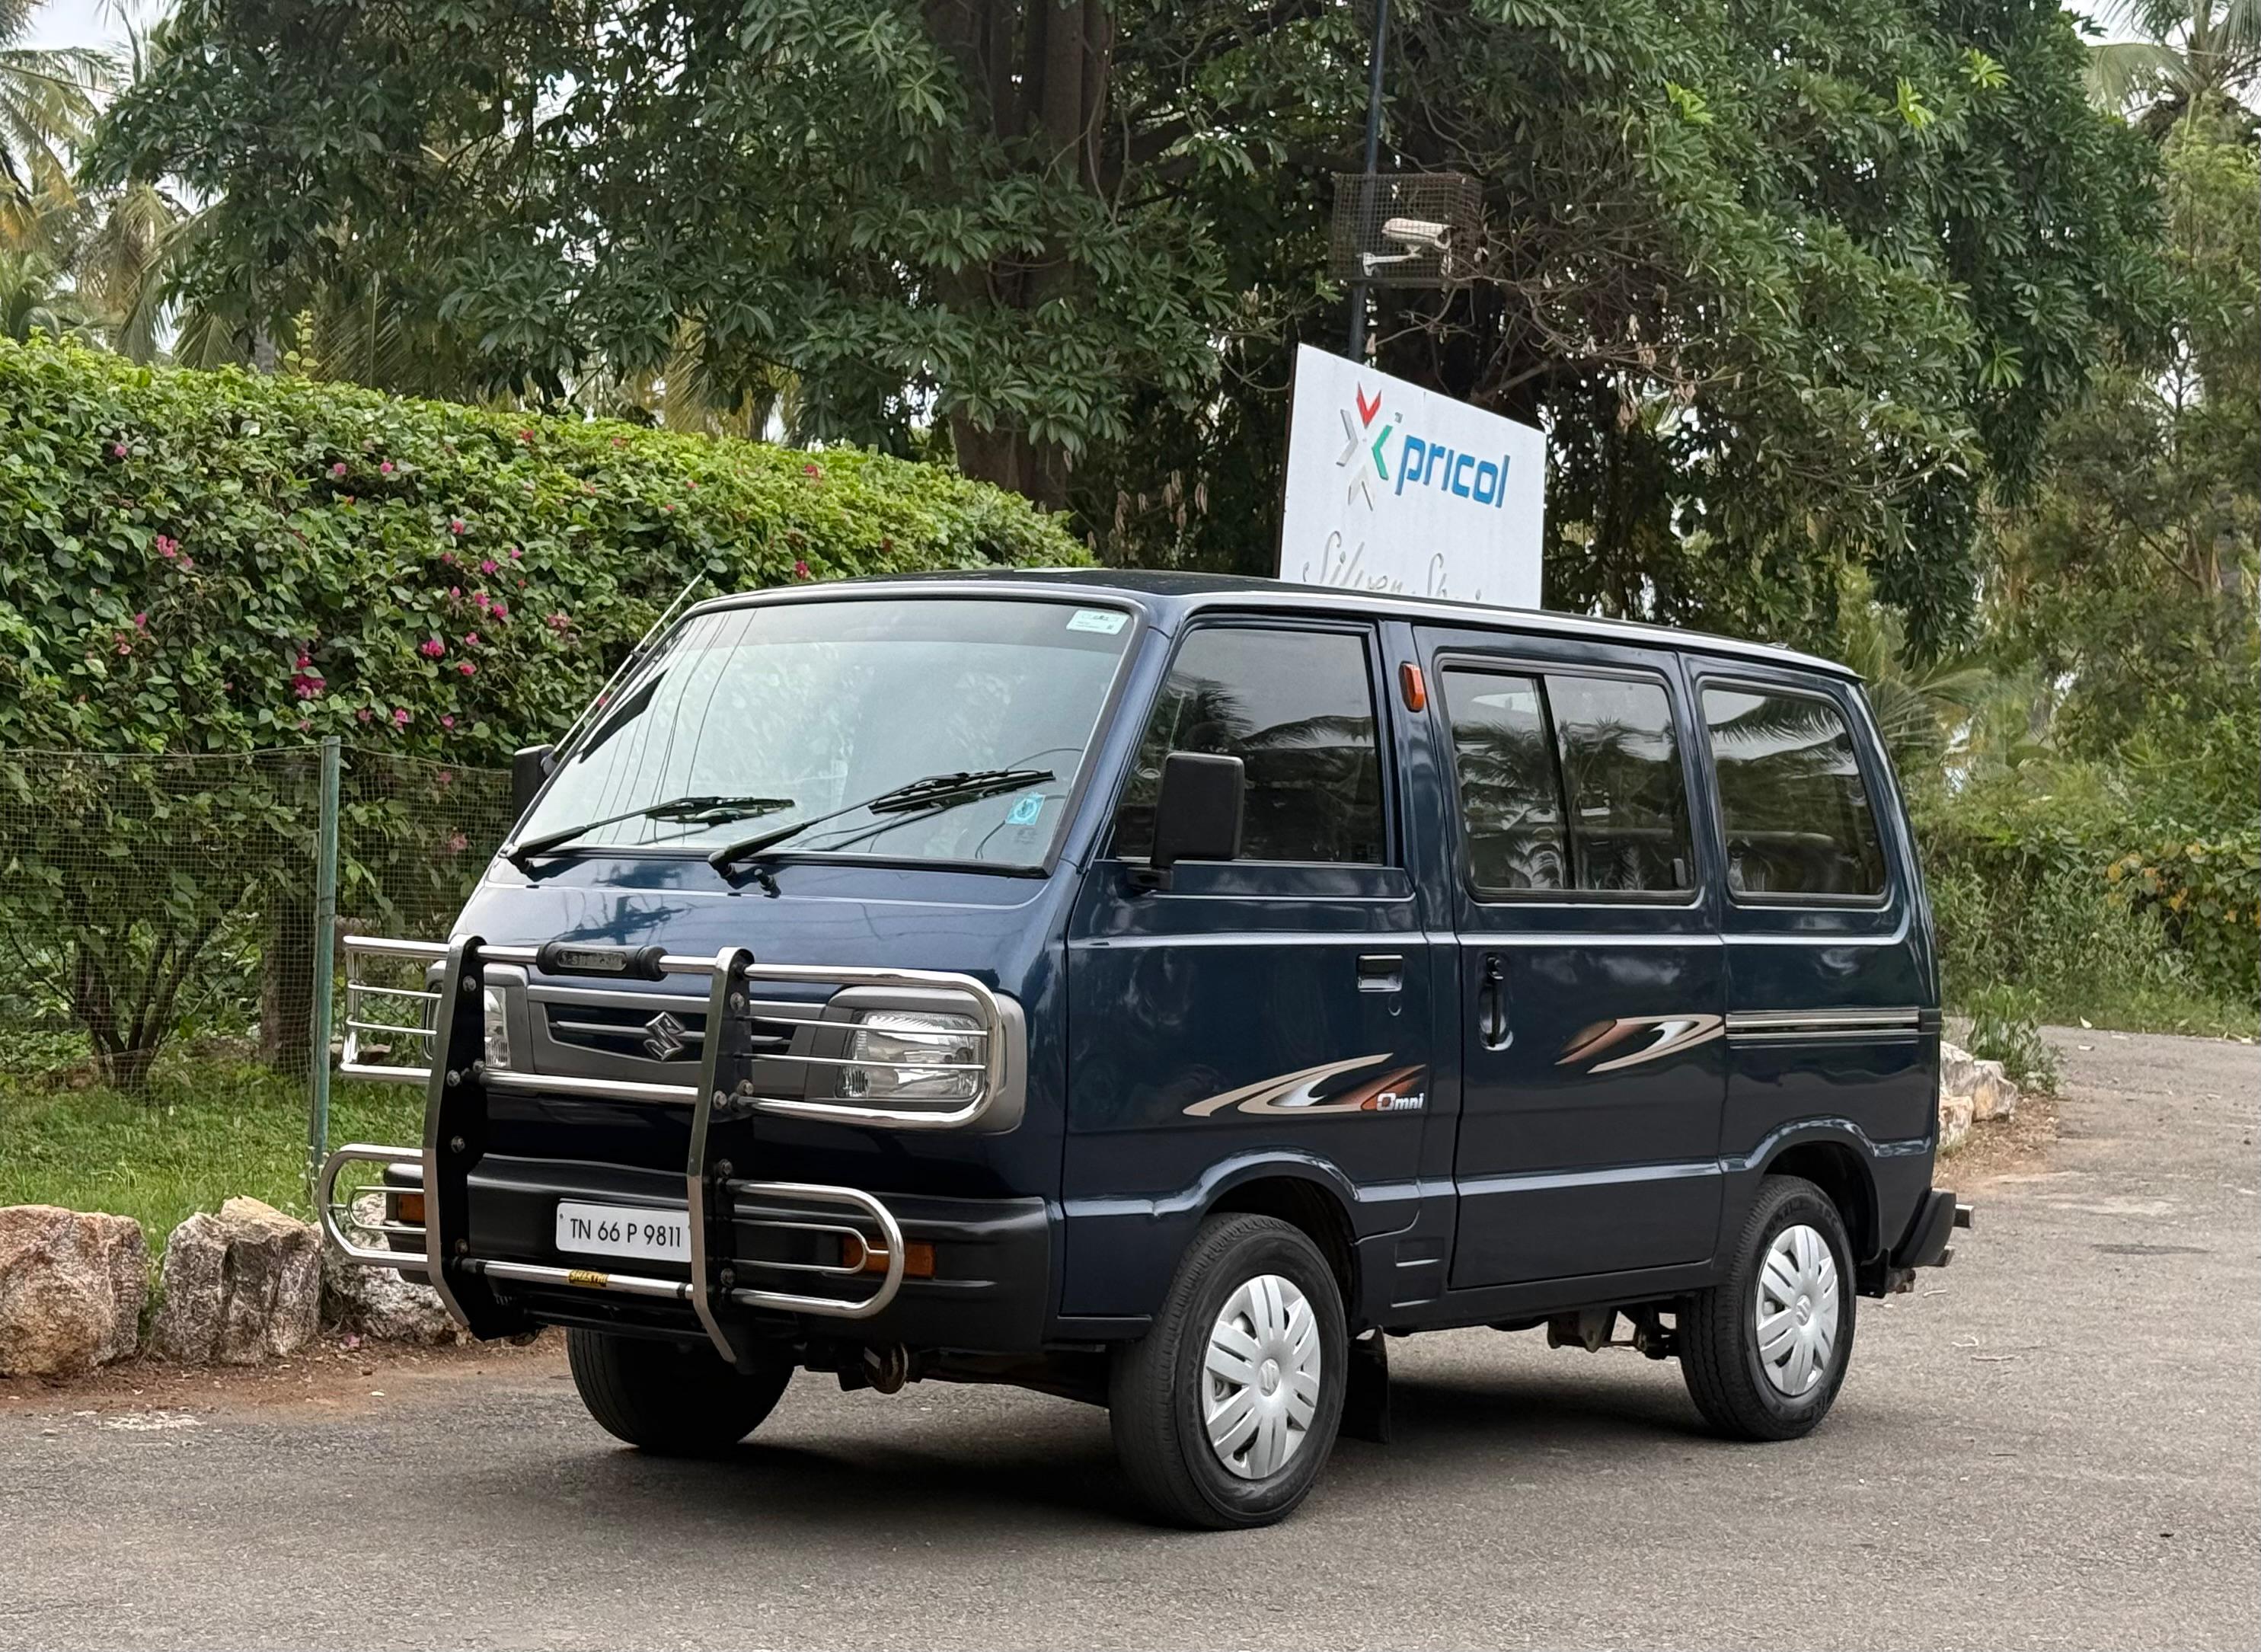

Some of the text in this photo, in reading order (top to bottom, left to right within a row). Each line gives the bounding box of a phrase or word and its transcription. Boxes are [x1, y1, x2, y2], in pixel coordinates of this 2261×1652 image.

[1395, 435, 1510, 508] pricol
[1377, 1092, 1425, 1111] Omni
[570, 1218, 680, 1248] TN 66 P 9811
